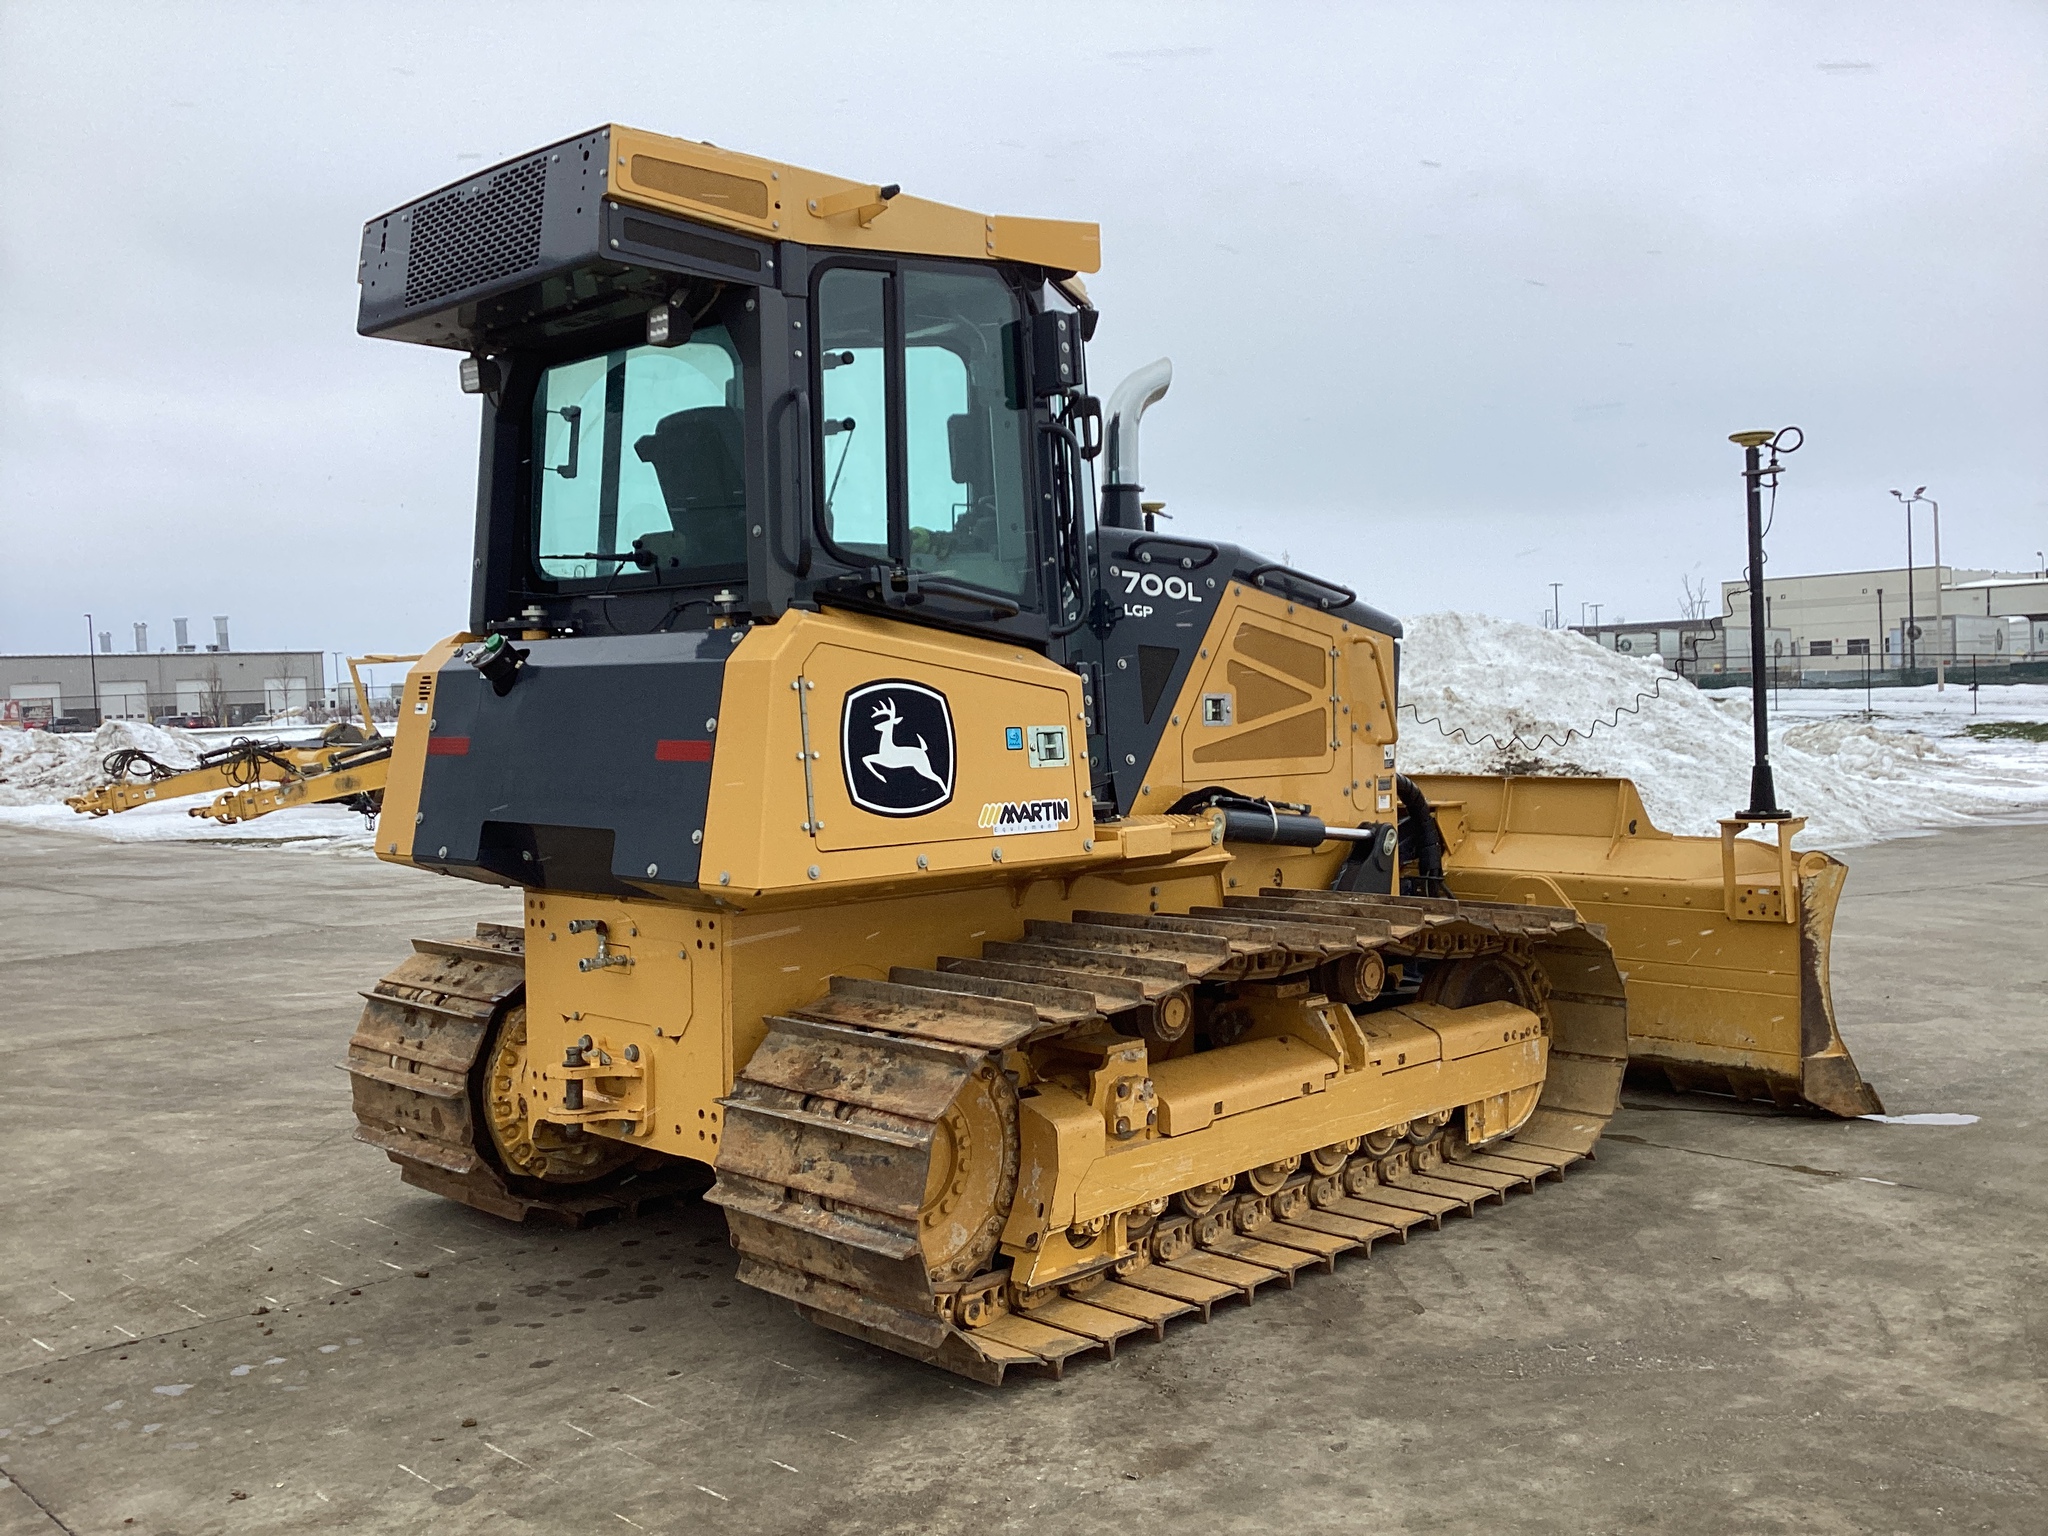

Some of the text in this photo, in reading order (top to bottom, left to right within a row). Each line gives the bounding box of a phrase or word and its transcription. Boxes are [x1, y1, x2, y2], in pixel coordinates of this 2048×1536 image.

[1121, 570, 1202, 602] 700L
[1124, 603, 1153, 617] LGP
[999, 800, 1068, 824] MARTIN
